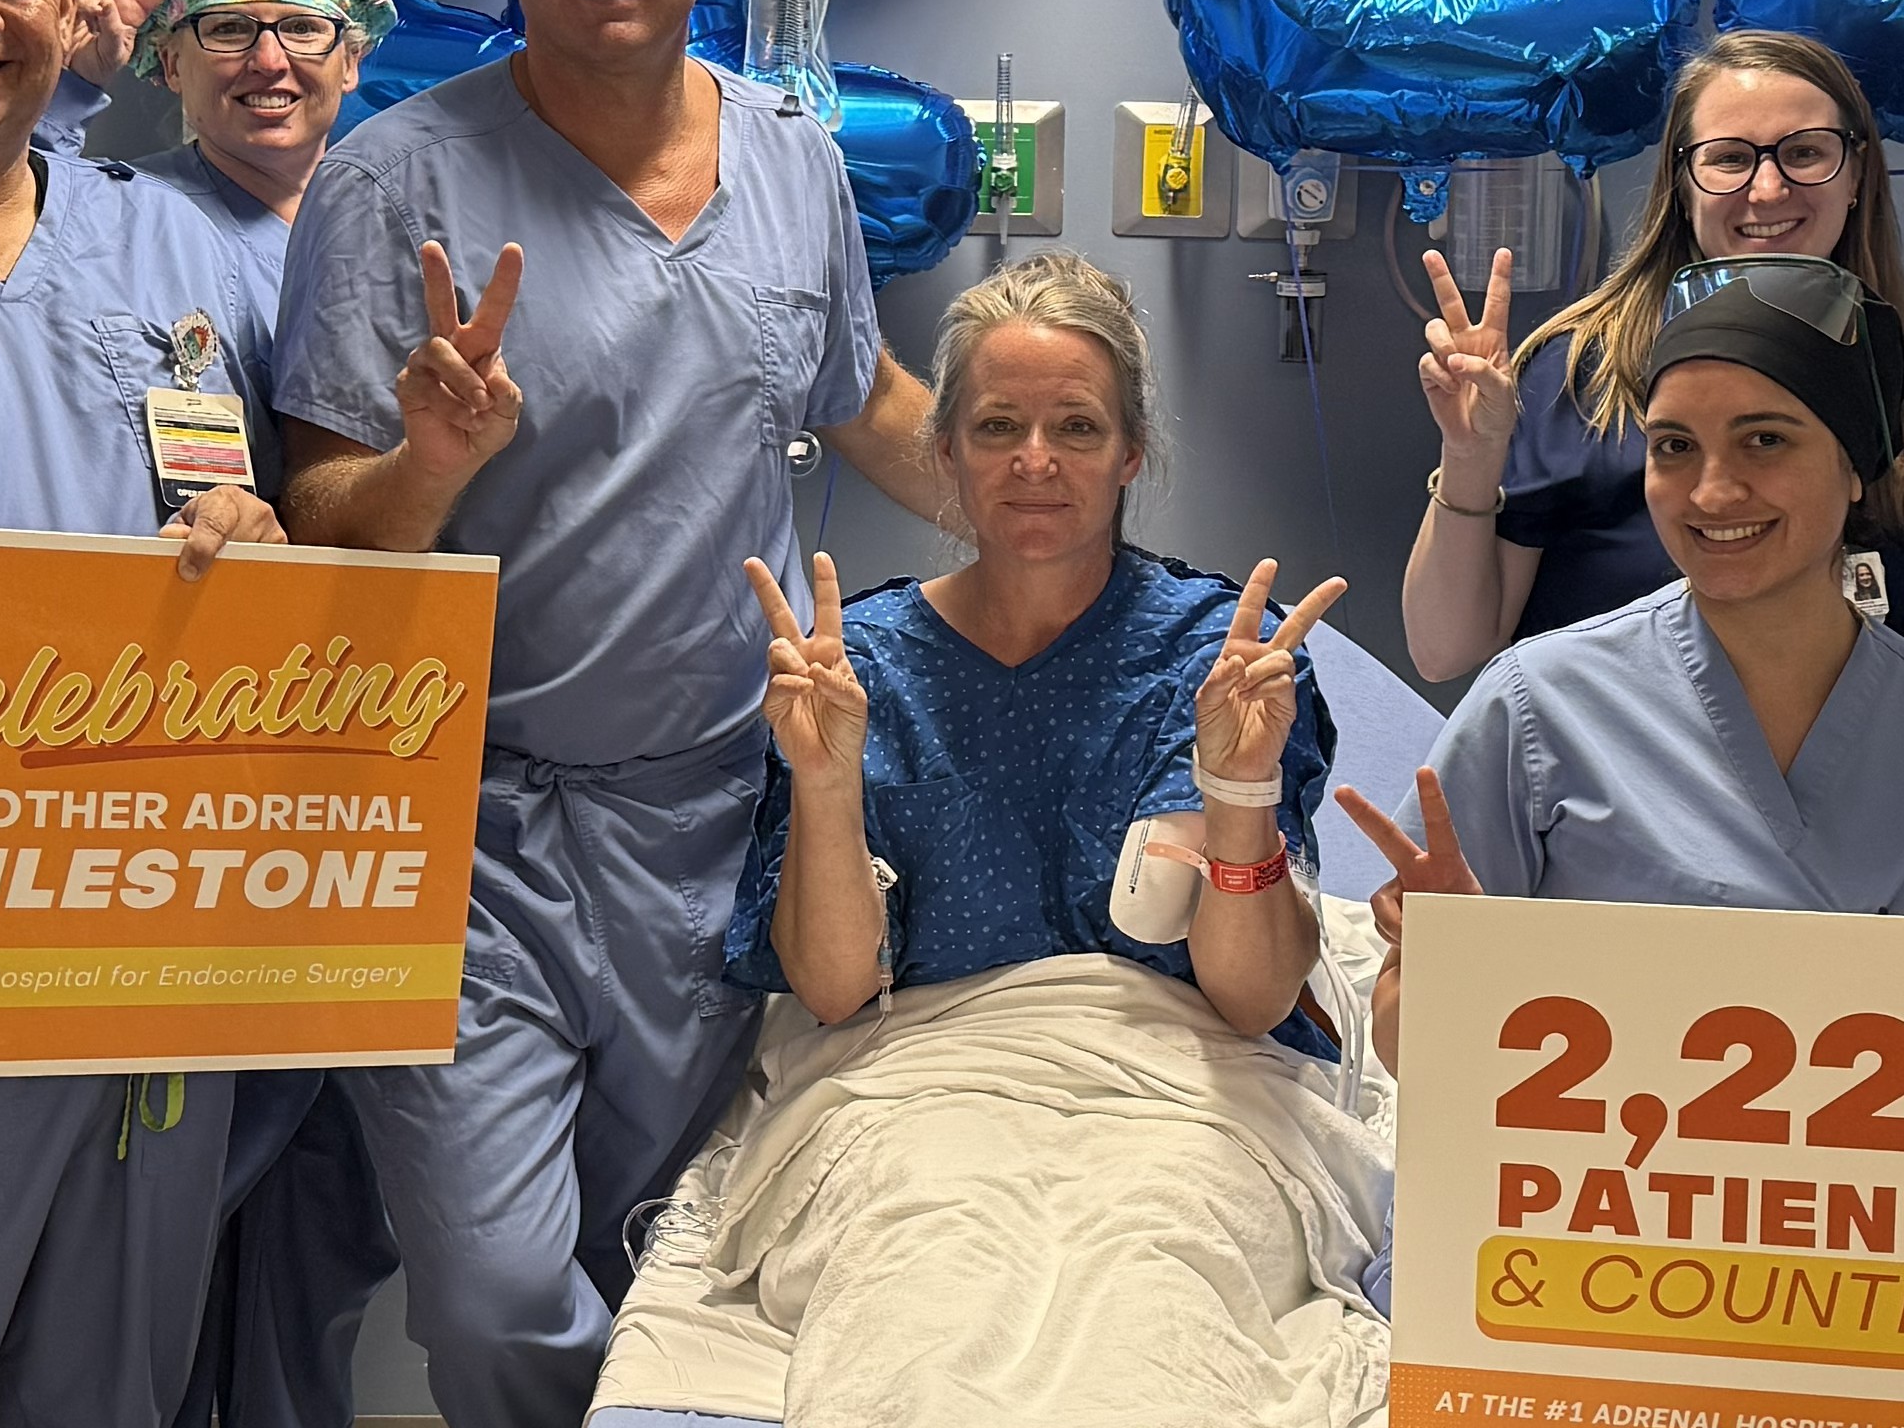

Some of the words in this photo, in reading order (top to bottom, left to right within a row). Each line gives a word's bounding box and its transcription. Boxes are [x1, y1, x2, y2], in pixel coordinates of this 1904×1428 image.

[182, 792, 424, 833] ADRENAL
[111, 965, 150, 987] for
[158, 963, 298, 987] Endocrine
[305, 962, 413, 989] Surgery
[1490, 1247, 1546, 1310] &
[1434, 1390, 1474, 1415] AT
[1482, 1393, 1536, 1420] THE
[1543, 1399, 1584, 1424] #1
